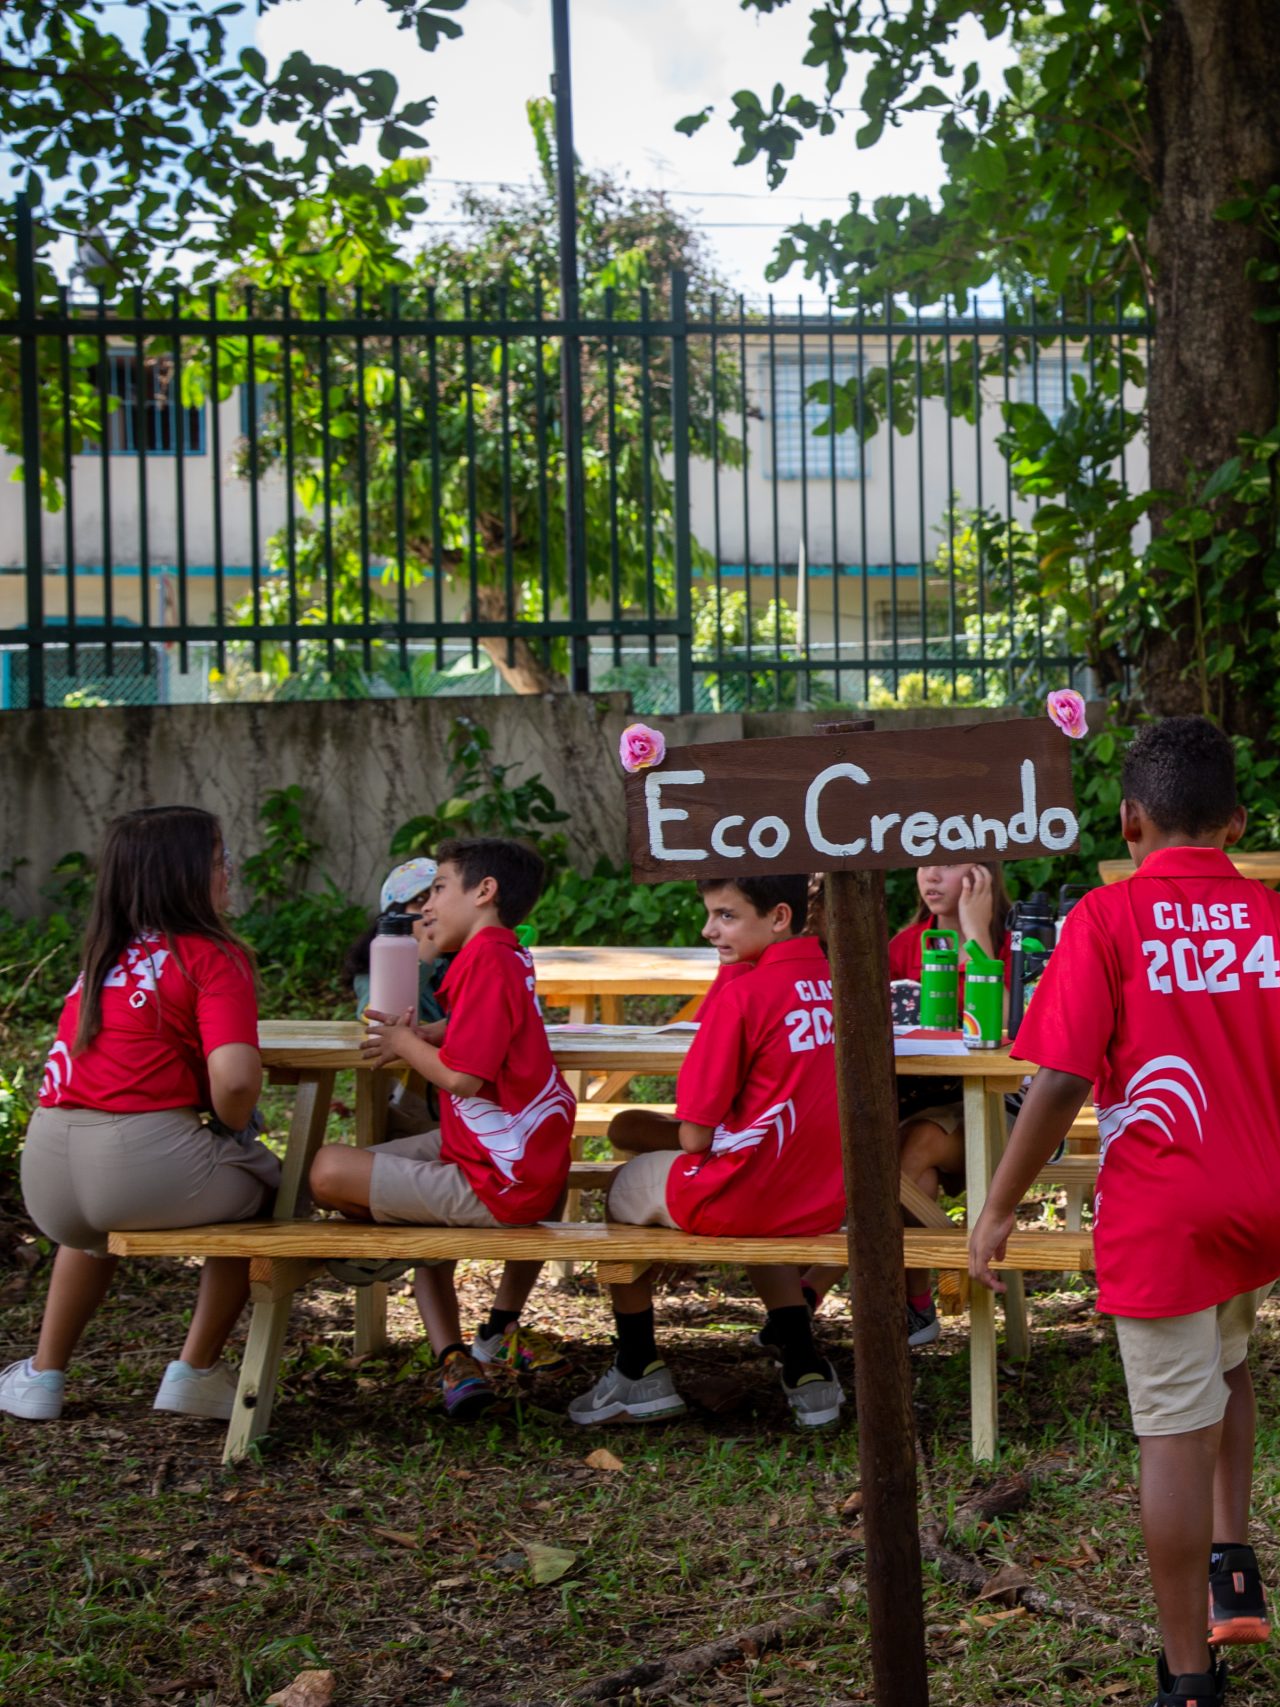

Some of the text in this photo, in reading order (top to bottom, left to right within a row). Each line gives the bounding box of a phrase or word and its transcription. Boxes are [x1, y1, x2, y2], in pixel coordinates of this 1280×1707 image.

[645, 758, 1079, 861] Eco Creando
[1153, 901, 1250, 932] CLASE
[1141, 935, 1280, 994] 2024
[784, 1007, 835, 1053] 20
